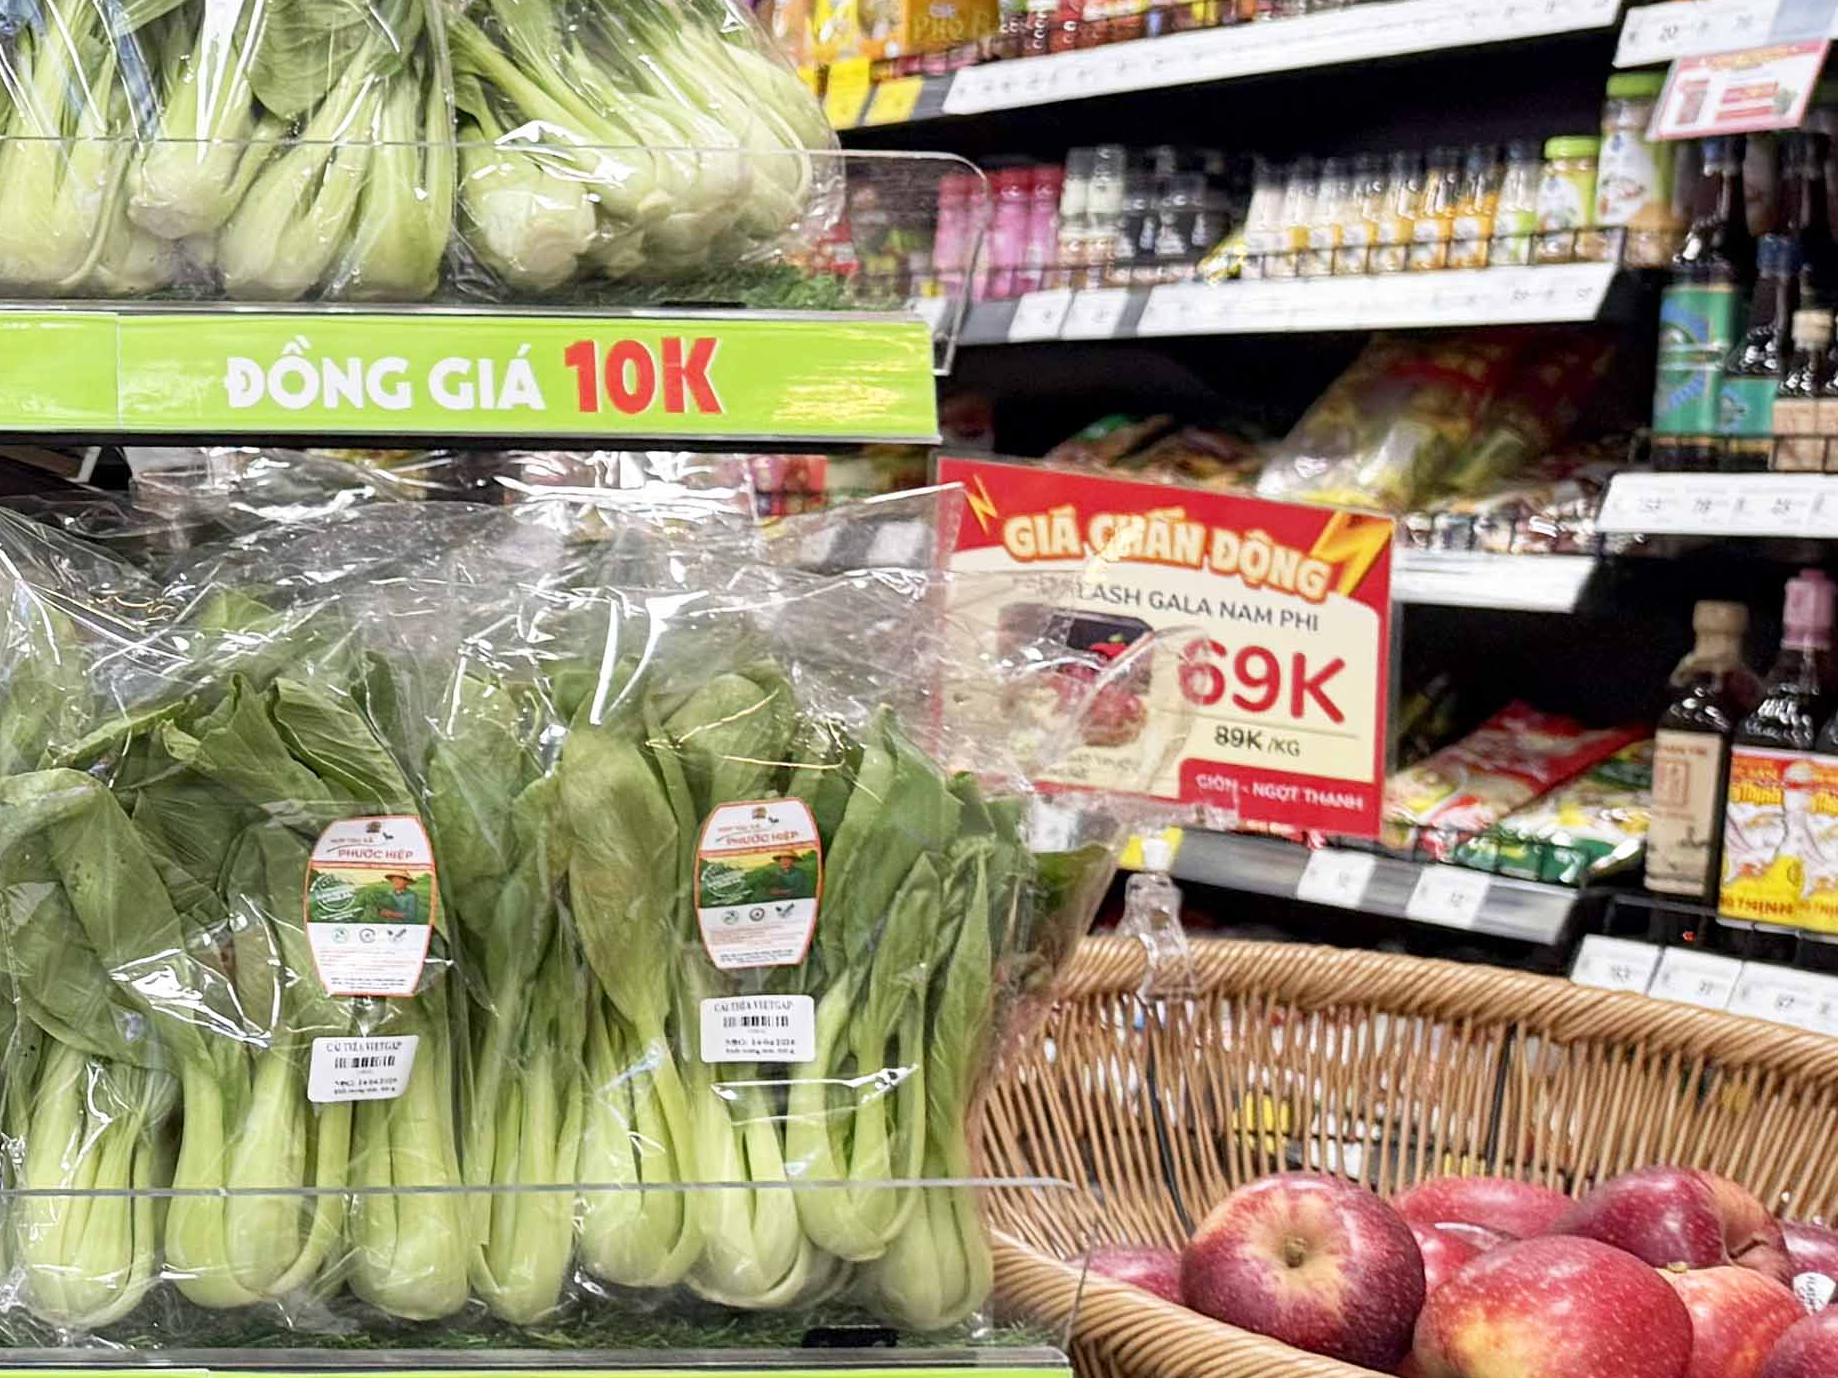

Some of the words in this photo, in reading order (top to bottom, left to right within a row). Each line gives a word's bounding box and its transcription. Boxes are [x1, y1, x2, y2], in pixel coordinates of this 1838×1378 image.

[224, 335, 412, 410] ĐỒNG
[429, 340, 544, 411] GIÁ
[565, 338, 722, 415] 10K
[1003, 505, 1080, 561] GIÁ
[1089, 506, 1205, 569] CHẤN
[1209, 533, 1331, 604] ĐỘNG
[1147, 589, 1212, 618] GALA
[1218, 600, 1273, 625] NAM
[1277, 607, 1320, 632] PHI
[1178, 637, 1347, 725] 69K
[1213, 725, 1265, 753] 89K
[1267, 737, 1302, 758] /KG
[1252, 780, 1302, 804] NGỌT
[1303, 787, 1365, 811] THANH
